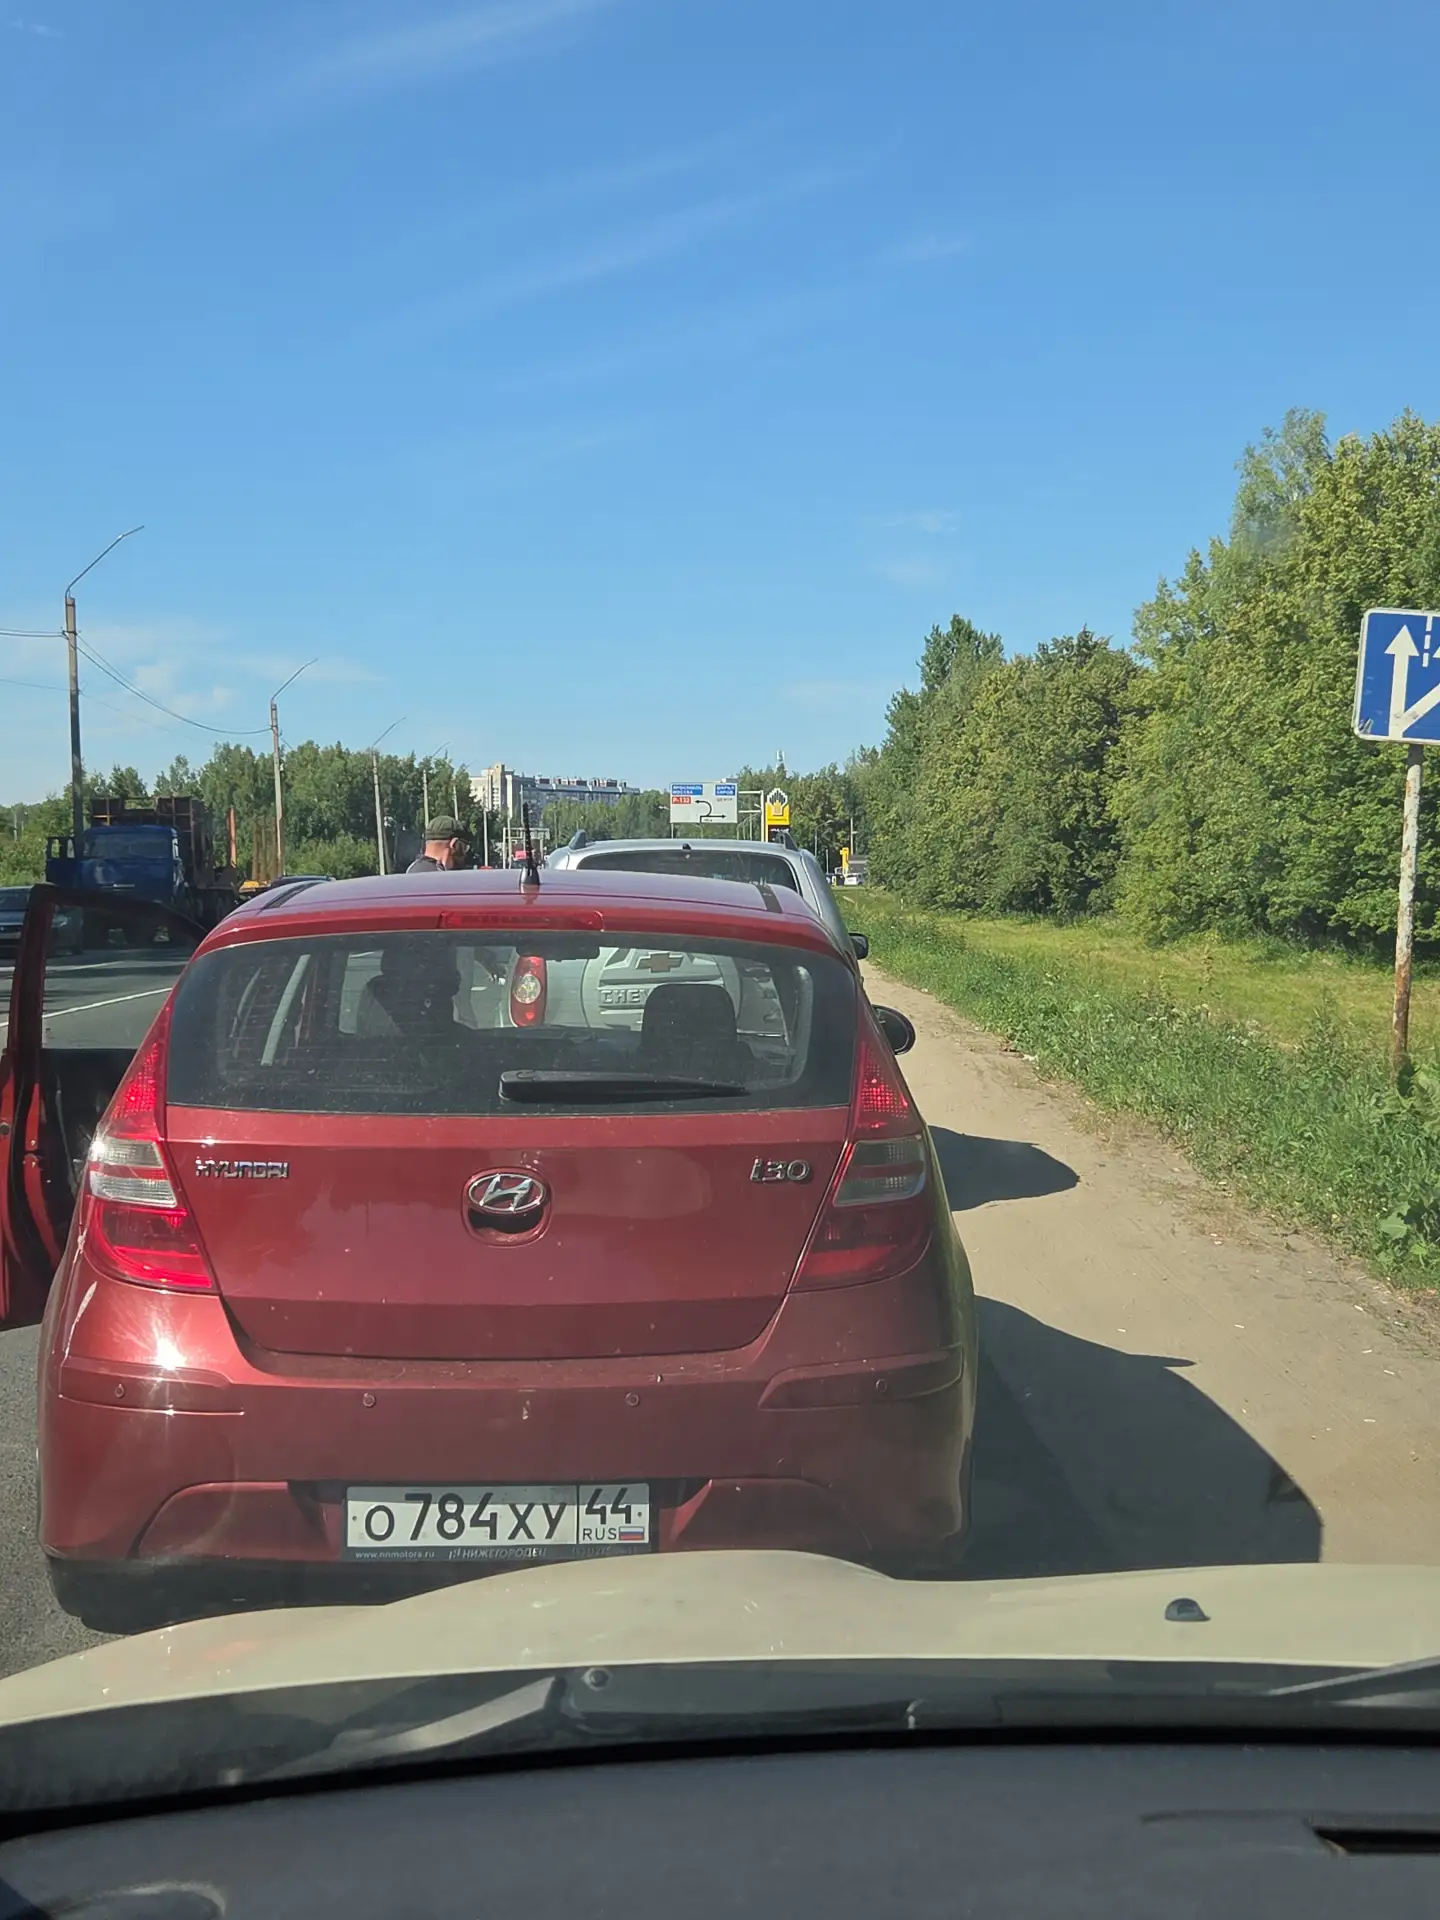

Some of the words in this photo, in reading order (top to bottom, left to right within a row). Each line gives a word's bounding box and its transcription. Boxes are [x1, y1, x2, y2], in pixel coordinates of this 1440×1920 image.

[195, 1160, 289, 1178] HYUNDAI
[585, 1487, 633, 1525] 44
[582, 1527, 618, 1541] RUS
